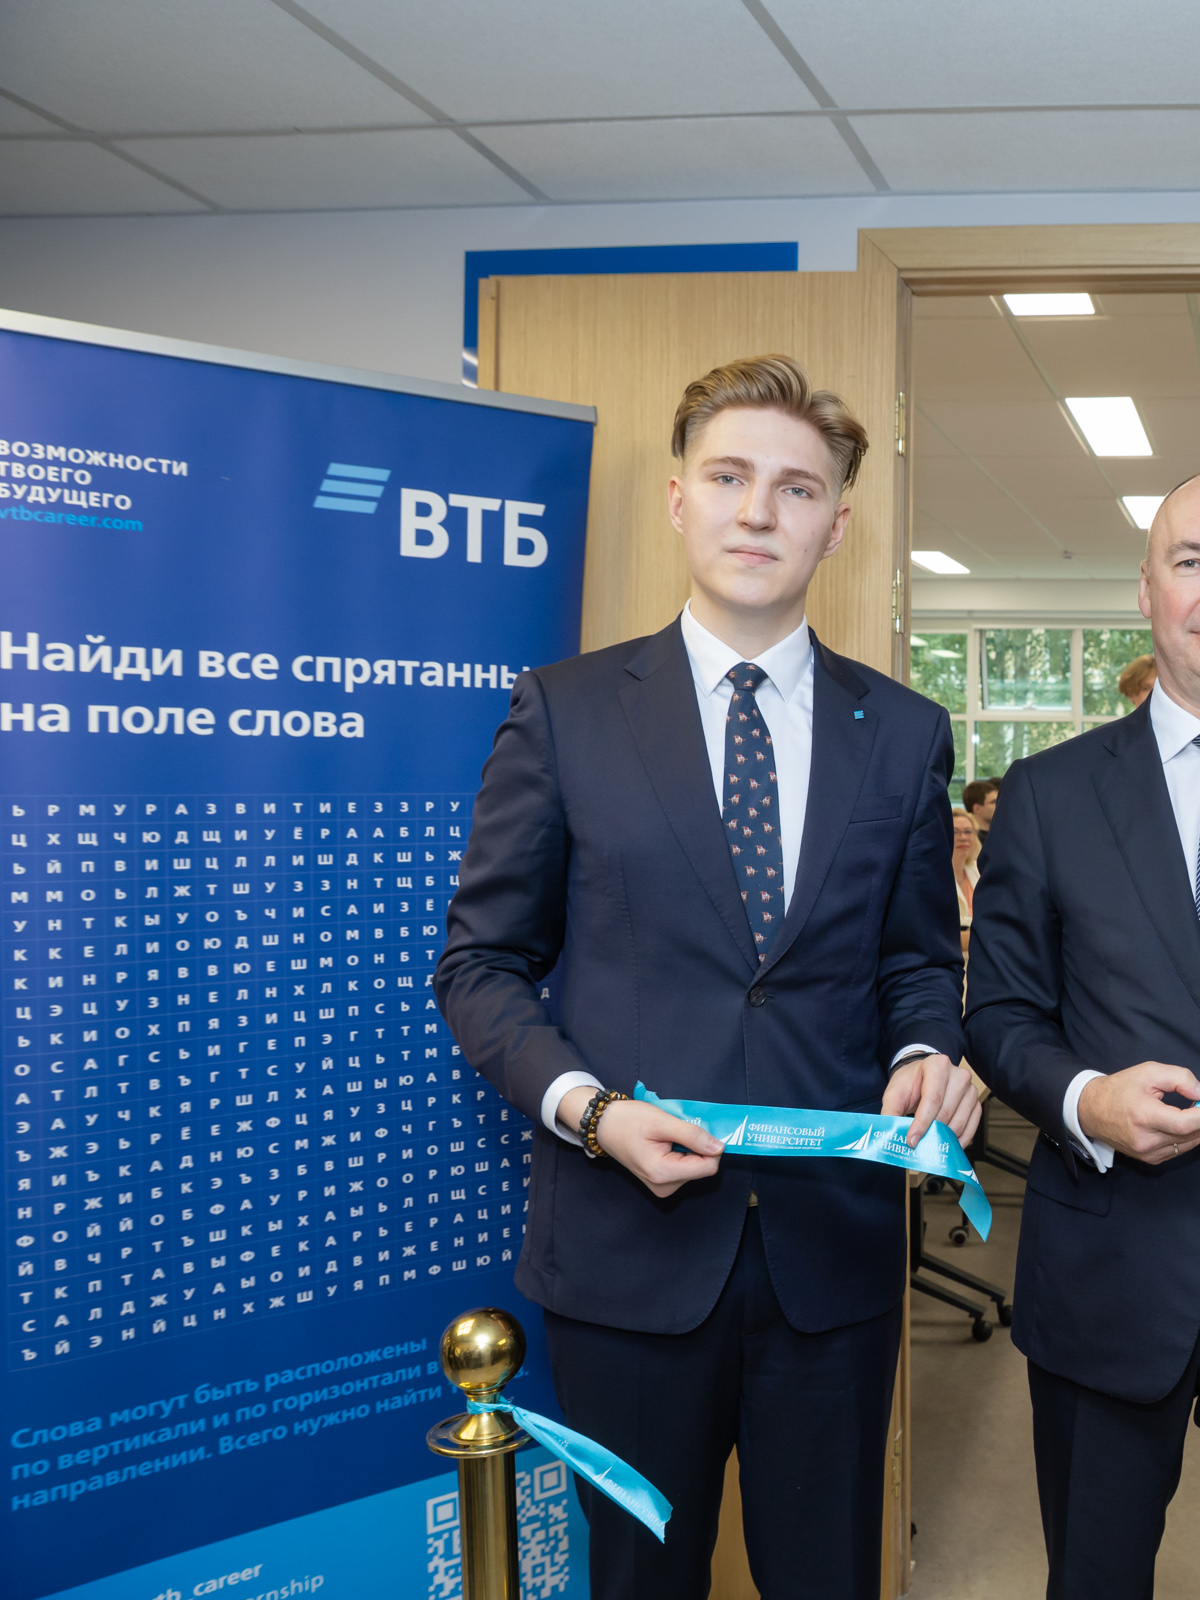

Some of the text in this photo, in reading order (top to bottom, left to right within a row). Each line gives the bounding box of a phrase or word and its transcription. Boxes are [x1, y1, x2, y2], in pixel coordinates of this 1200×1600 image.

[0, 439, 188, 477] ВОЗМОЖНОСТИ
[0, 461, 92, 486] ТВОЕГО
[0, 482, 132, 511] БУДУЩЕГО
[0, 504, 144, 532] vtbcareer.com
[400, 487, 549, 568] ВТБ
[0, 631, 183, 682] Найди
[199, 649, 279, 681] все
[0, 702, 365, 739] на поле слова
[747, 1132, 824, 1147] УНИВЕРСИТЕТ
[748, 1123, 825, 1137] ФИНАНСОВЫЙ
[10, 1416, 102, 1449] Слова
[109, 1393, 189, 1427] могут
[193, 1378, 259, 1405] быть
[264, 1338, 427, 1393] расположены
[11, 1360, 439, 1481] по вертикали и по горизонтали в
[11, 1446, 213, 1511] направлении.
[219, 1424, 288, 1455] Всего
[293, 1404, 370, 1436] нужно
[375, 1384, 442, 1413] найти
